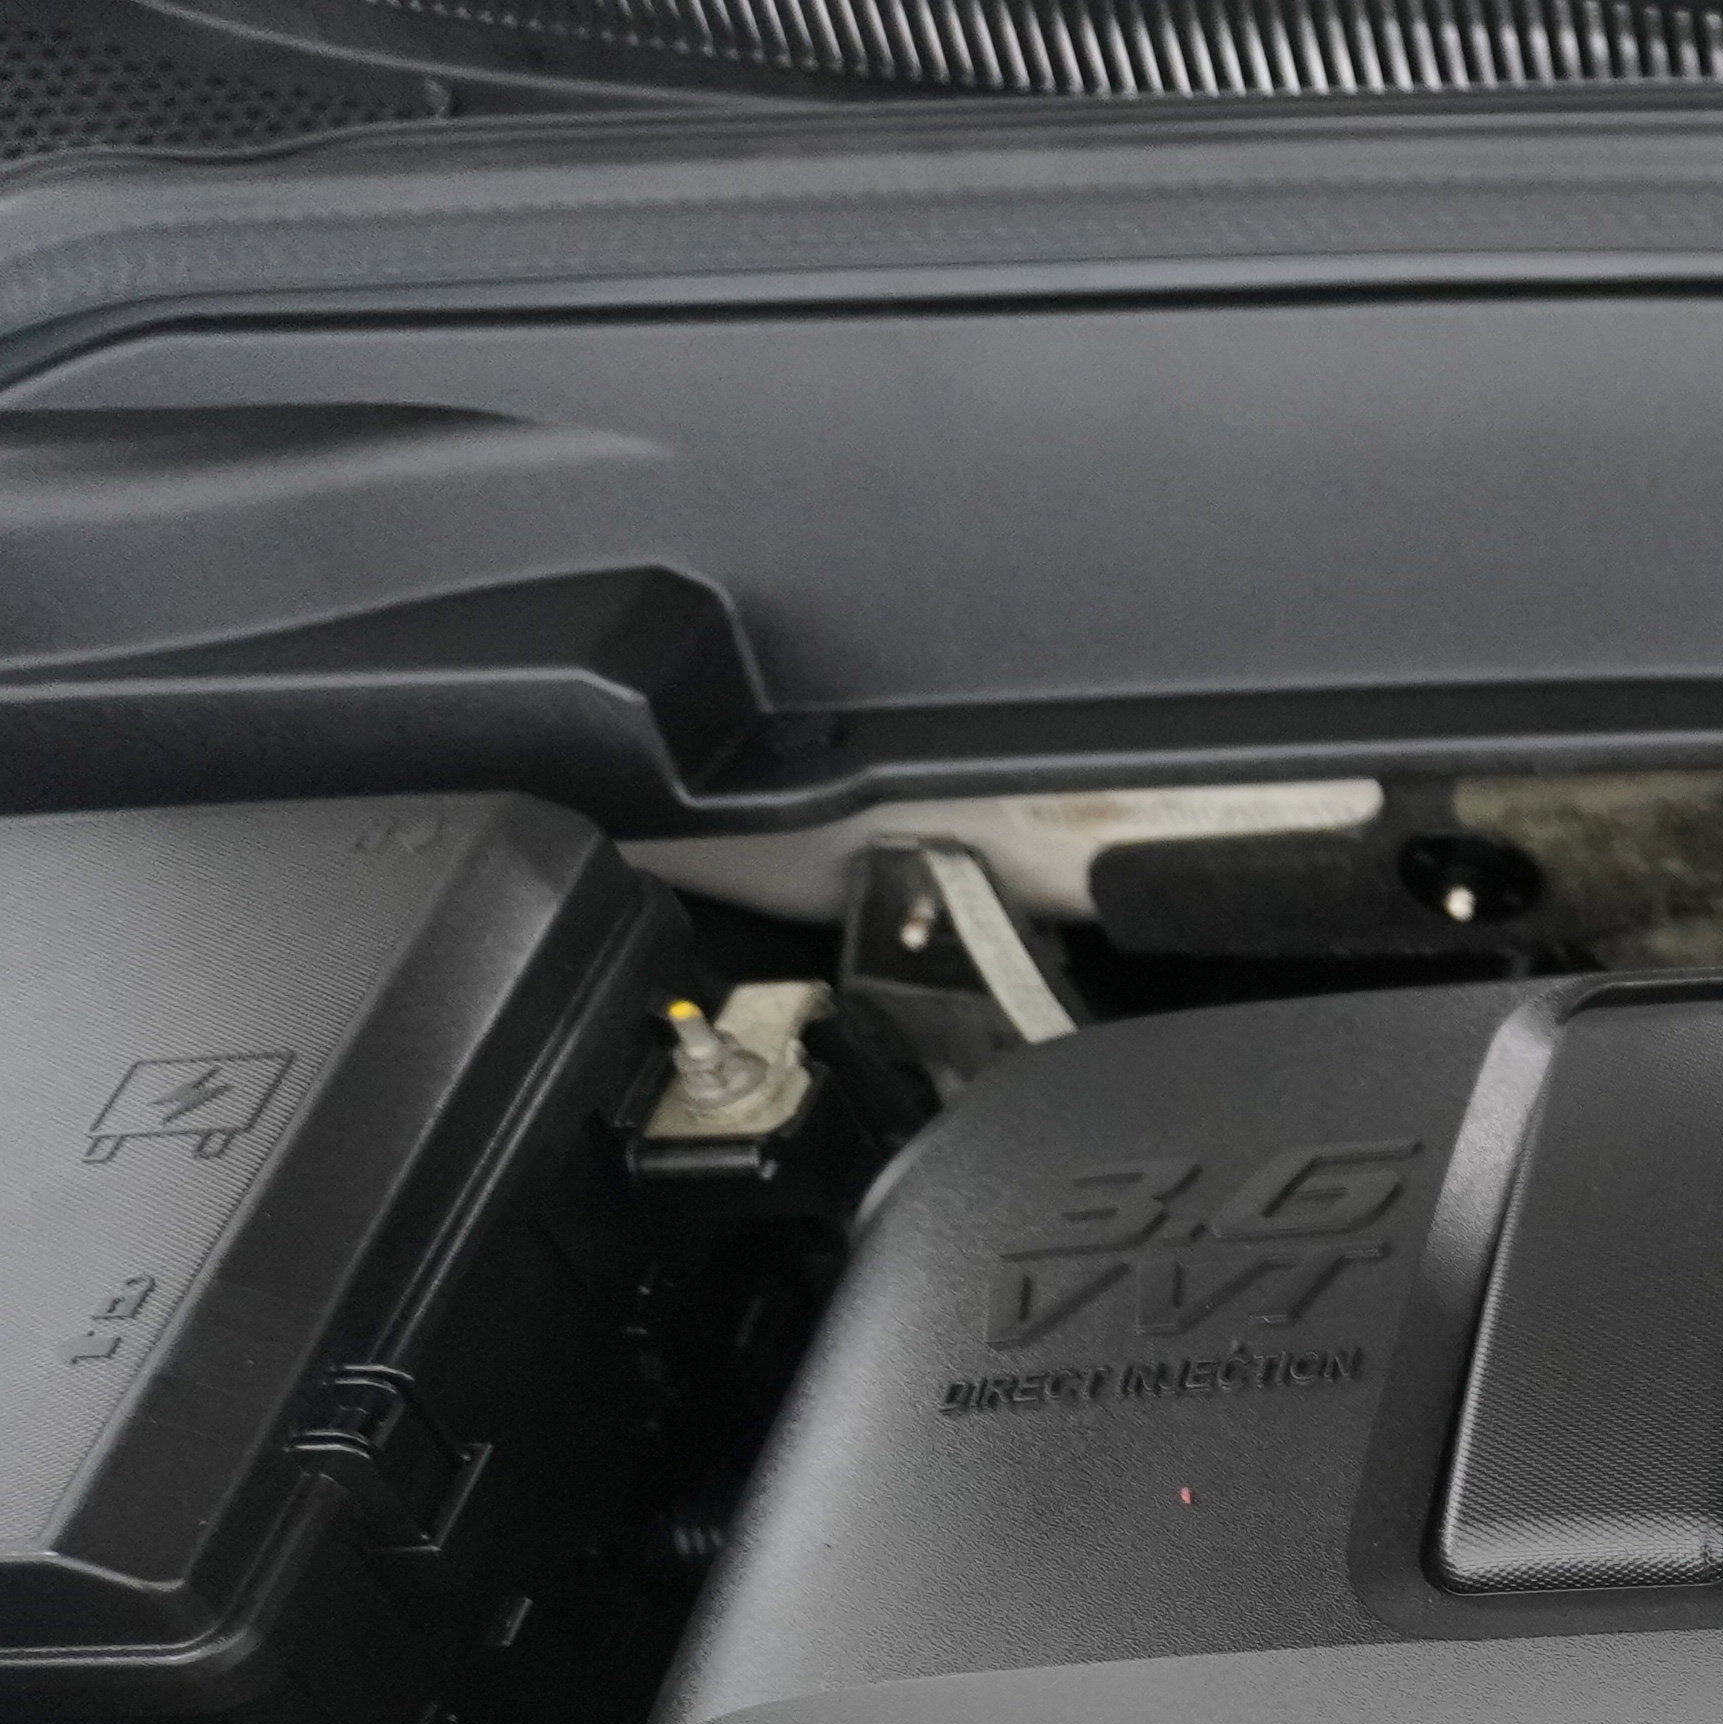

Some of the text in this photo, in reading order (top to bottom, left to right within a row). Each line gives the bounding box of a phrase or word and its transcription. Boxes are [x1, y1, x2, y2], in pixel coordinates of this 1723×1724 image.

[1002, 1136, 1424, 1263] 3.6
[983, 1238, 1392, 1350] VVT
[938, 1345, 1366, 1417] DIRECT INJECTION
